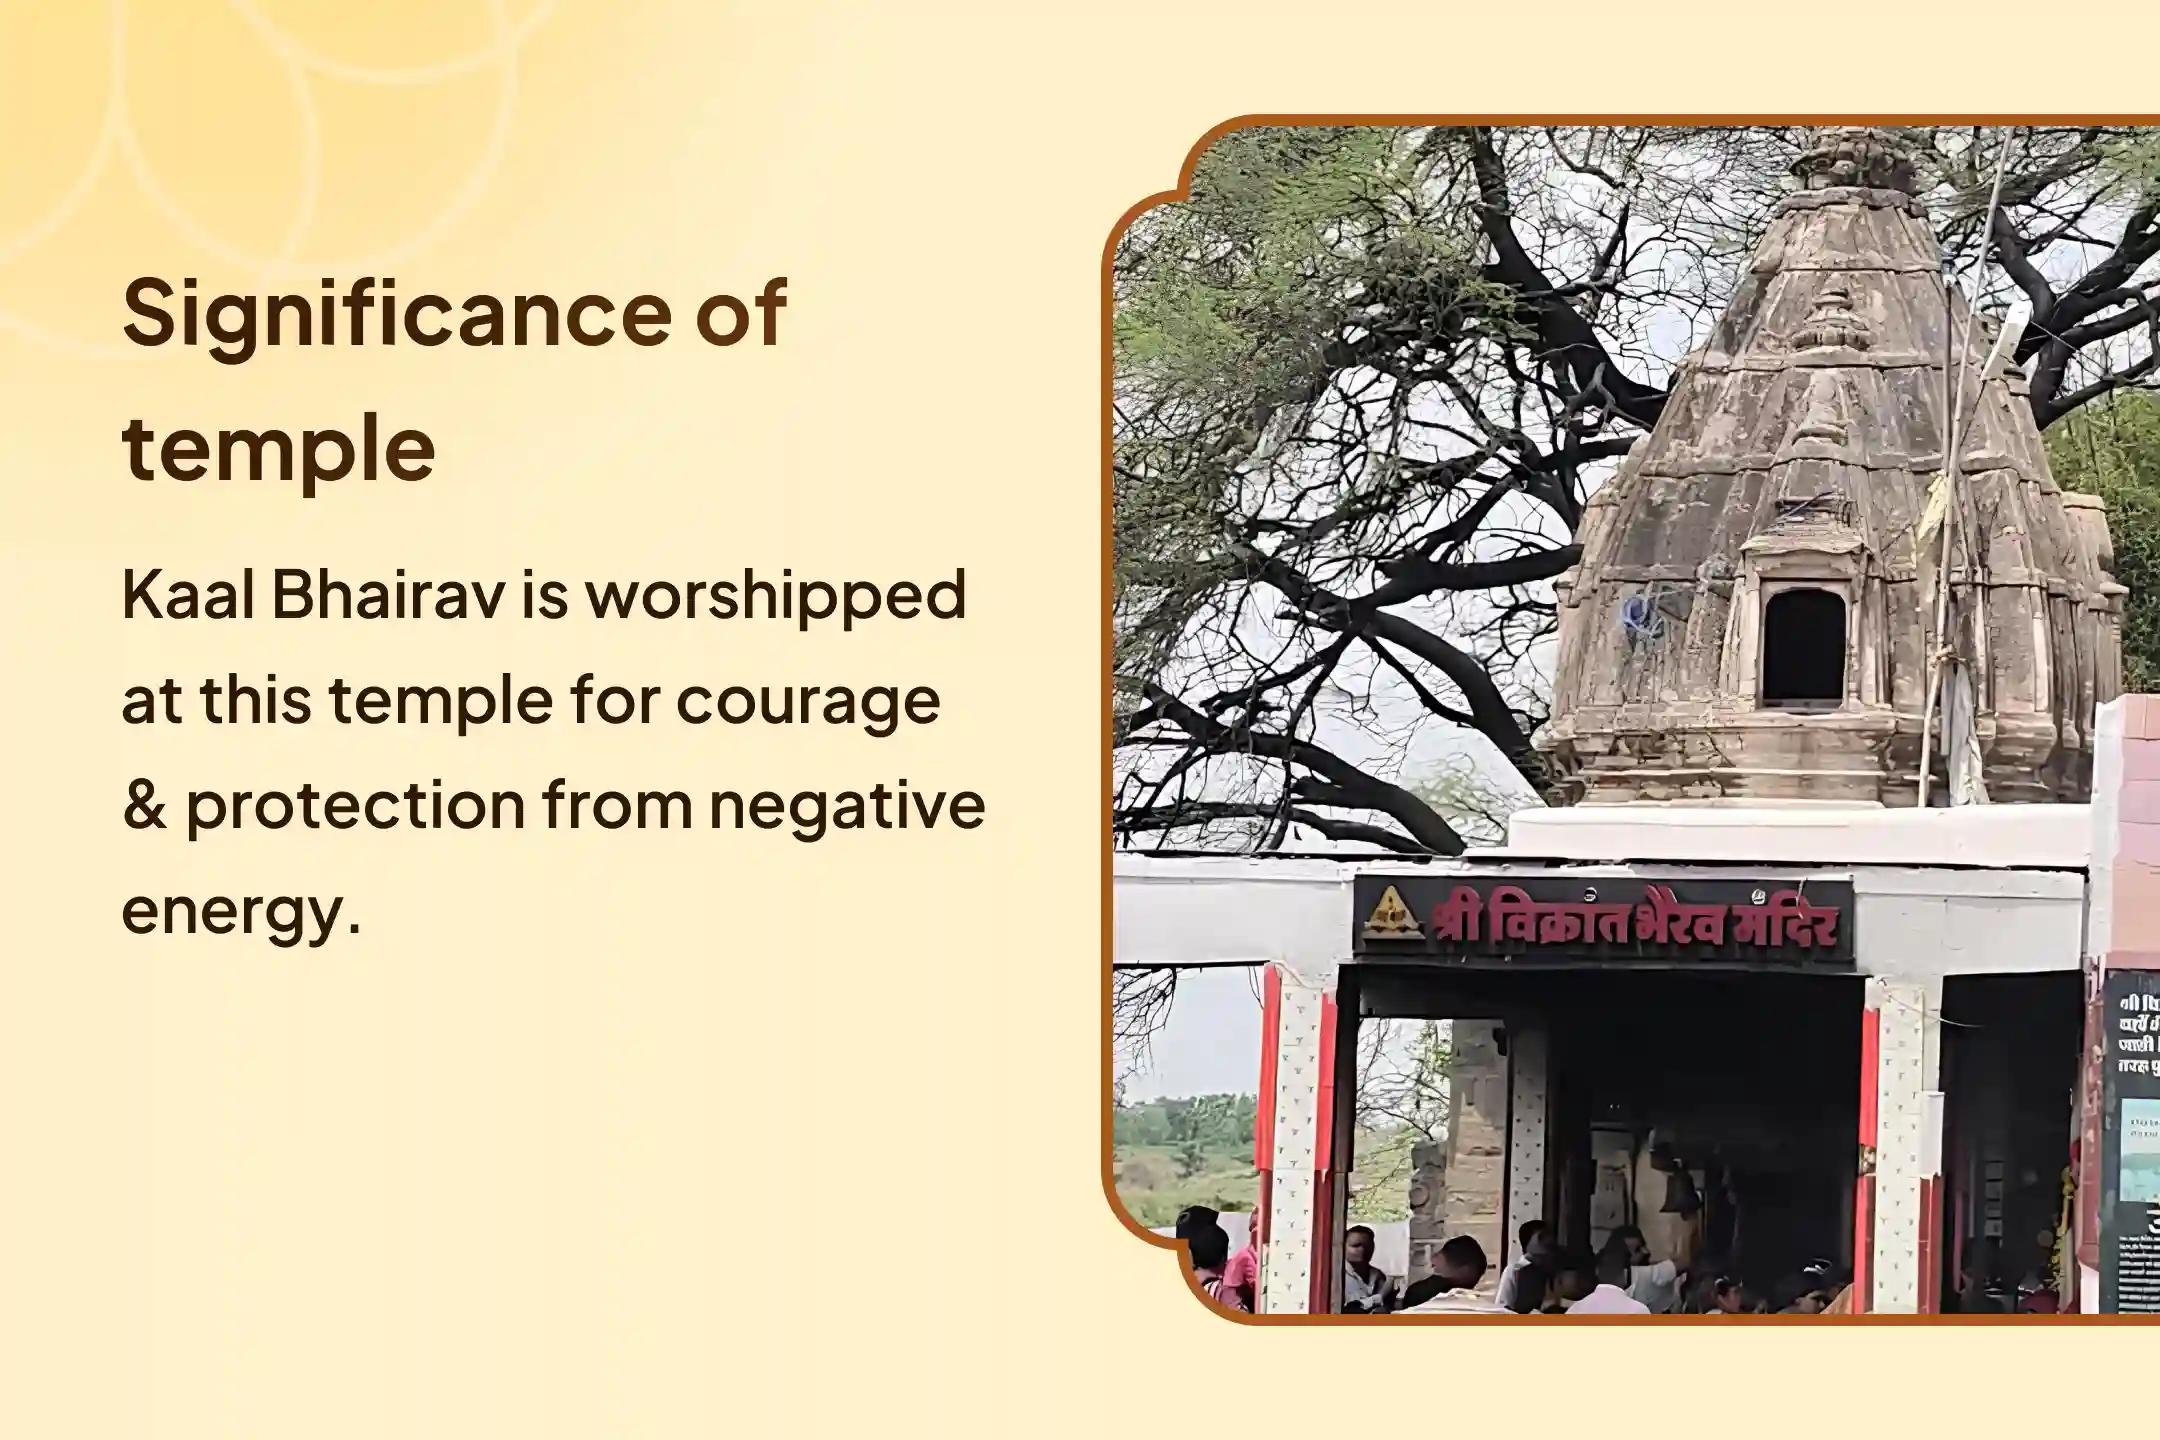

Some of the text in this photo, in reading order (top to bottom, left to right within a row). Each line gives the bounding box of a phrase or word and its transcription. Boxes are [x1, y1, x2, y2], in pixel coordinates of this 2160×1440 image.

[1432, 885, 1483, 941] श्री
[1635, 884, 1728, 945] भैरव
[1731, 888, 1840, 947] मंदिर
